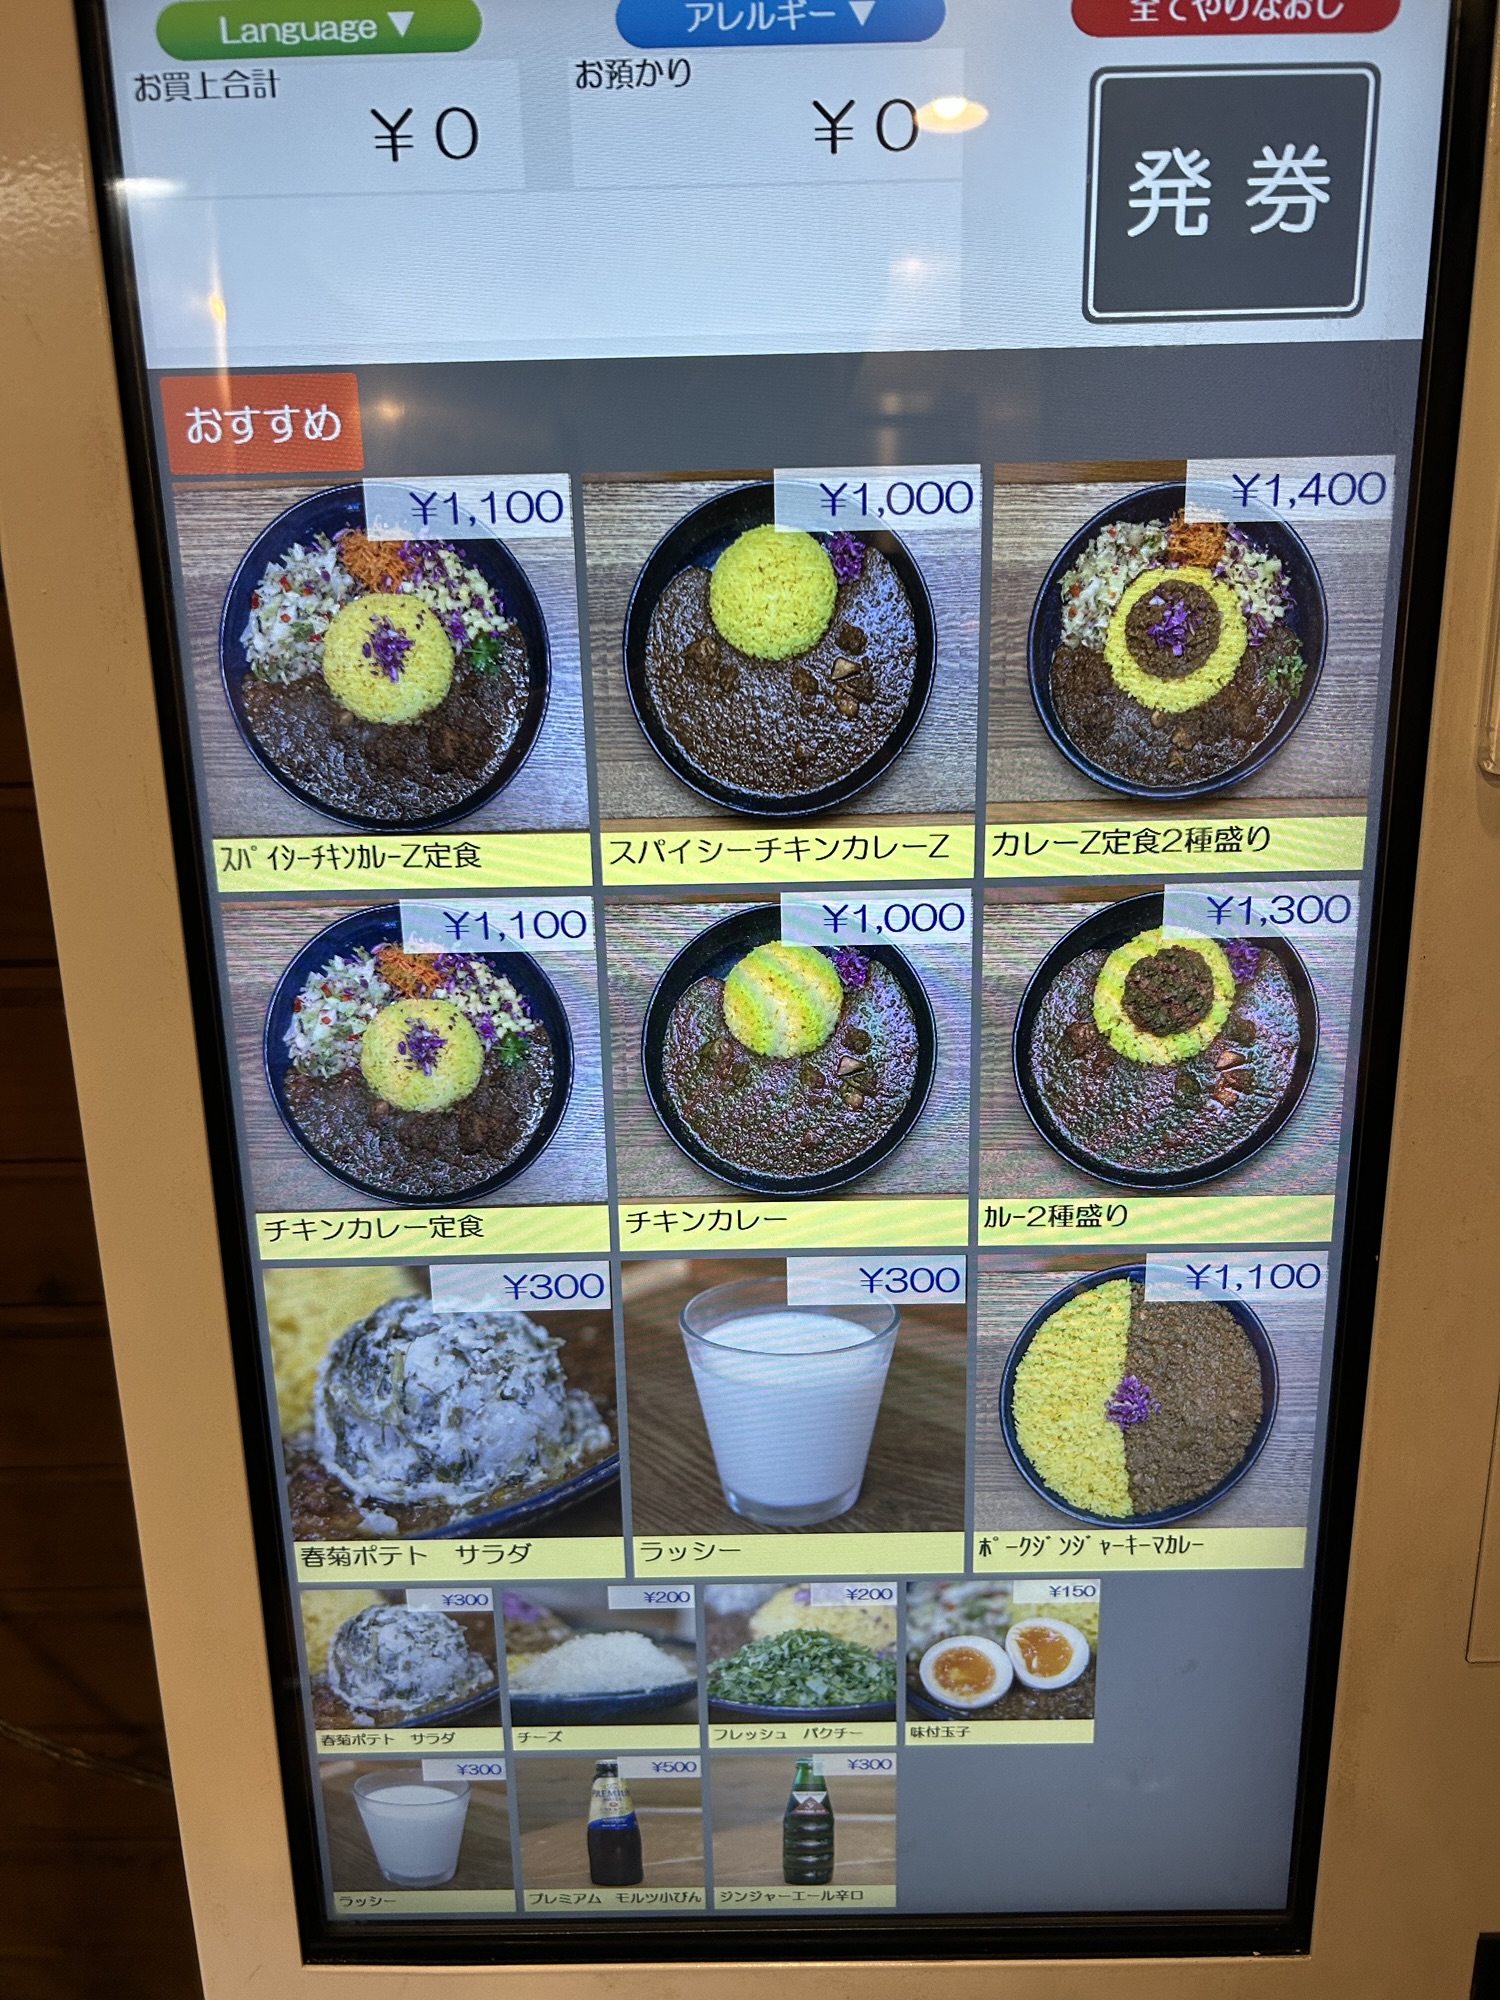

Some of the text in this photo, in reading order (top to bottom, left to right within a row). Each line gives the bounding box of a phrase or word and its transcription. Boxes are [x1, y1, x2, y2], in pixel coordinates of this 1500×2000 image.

[685, 0, 836, 33] アレルギー
[218, 15, 378, 46] Language
[133, 68, 281, 103] お買上合計
[575, 57, 692, 91] お預かり
[184, 404, 343, 445] おすすめ
[819, 480, 974, 517] ¥1,000
[1232, 471, 1388, 509] ¥1,400
[410, 489, 564, 527] ¥1,100
[610, 833, 951, 867] スパイシーチキンカレーZ
[990, 825, 1272, 857] カレーZ定食2種盛り
[822, 902, 966, 935] ¥1,000
[1206, 894, 1352, 927] ¥1,300
[443, 909, 588, 943] ¥1,100
[263, 1214, 486, 1242] チキンカレー定食
[625, 1209, 789, 1235] チキンカレー
[504, 1273, 606, 1302] ¥300
[859, 1266, 961, 1294] ¥300
[1185, 1262, 1323, 1293] ¥1,100
[300, 1542, 533, 1568] 春菊ポテト サラダ
[640, 1541, 742, 1563] ラッシー
[442, 1592, 490, 1607] ¥300
[644, 1590, 691, 1604] ¥200
[846, 1587, 894, 1601] ¥200
[1049, 1584, 1096, 1598] ¥150
[320, 1731, 456, 1747] 春菊ポテト サラダ
[517, 1729, 563, 1744] チーズ
[714, 1726, 864, 1741] フレッシュ パクチー
[910, 1725, 971, 1739] 味付玉子
[457, 1762, 503, 1776] ¥300
[651, 1760, 698, 1774] ¥500
[847, 1757, 893, 1772] ¥300
[338, 1895, 397, 1908] ラッシー
[528, 1891, 702, 1906] プレミアム モルツ小びん
[719, 1889, 864, 1903] ジンジャーエール辛口
